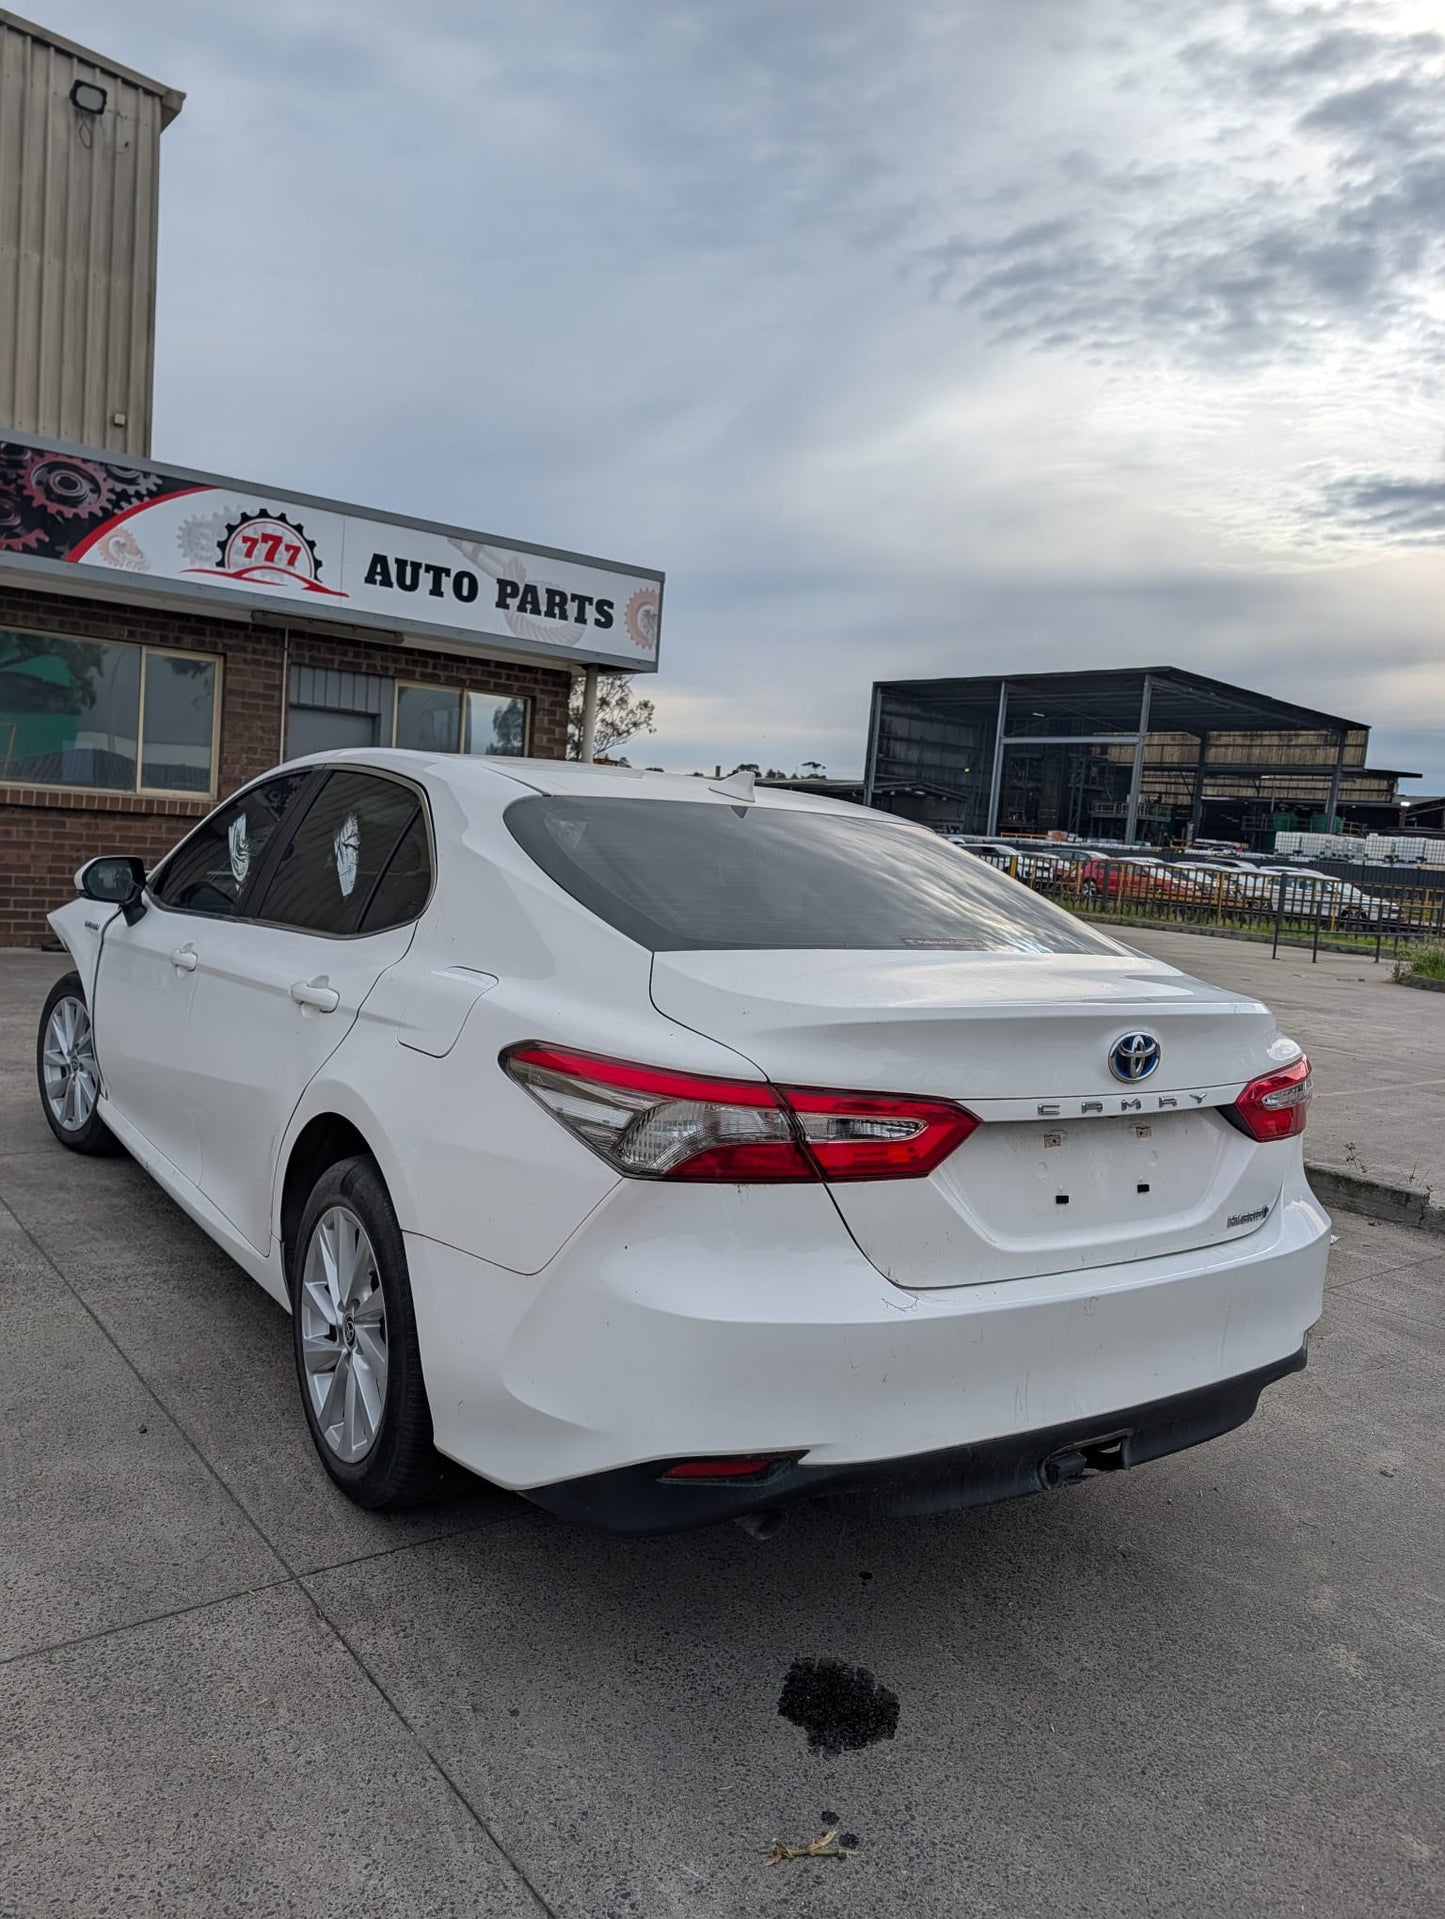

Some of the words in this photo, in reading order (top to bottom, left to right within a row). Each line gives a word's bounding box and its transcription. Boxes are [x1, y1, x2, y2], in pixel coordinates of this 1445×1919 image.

[242, 532, 302, 567] 777
[364, 553, 479, 603] AUTO
[495, 578, 615, 629] PARTS
[1037, 1092, 1208, 1116] CAMRY
